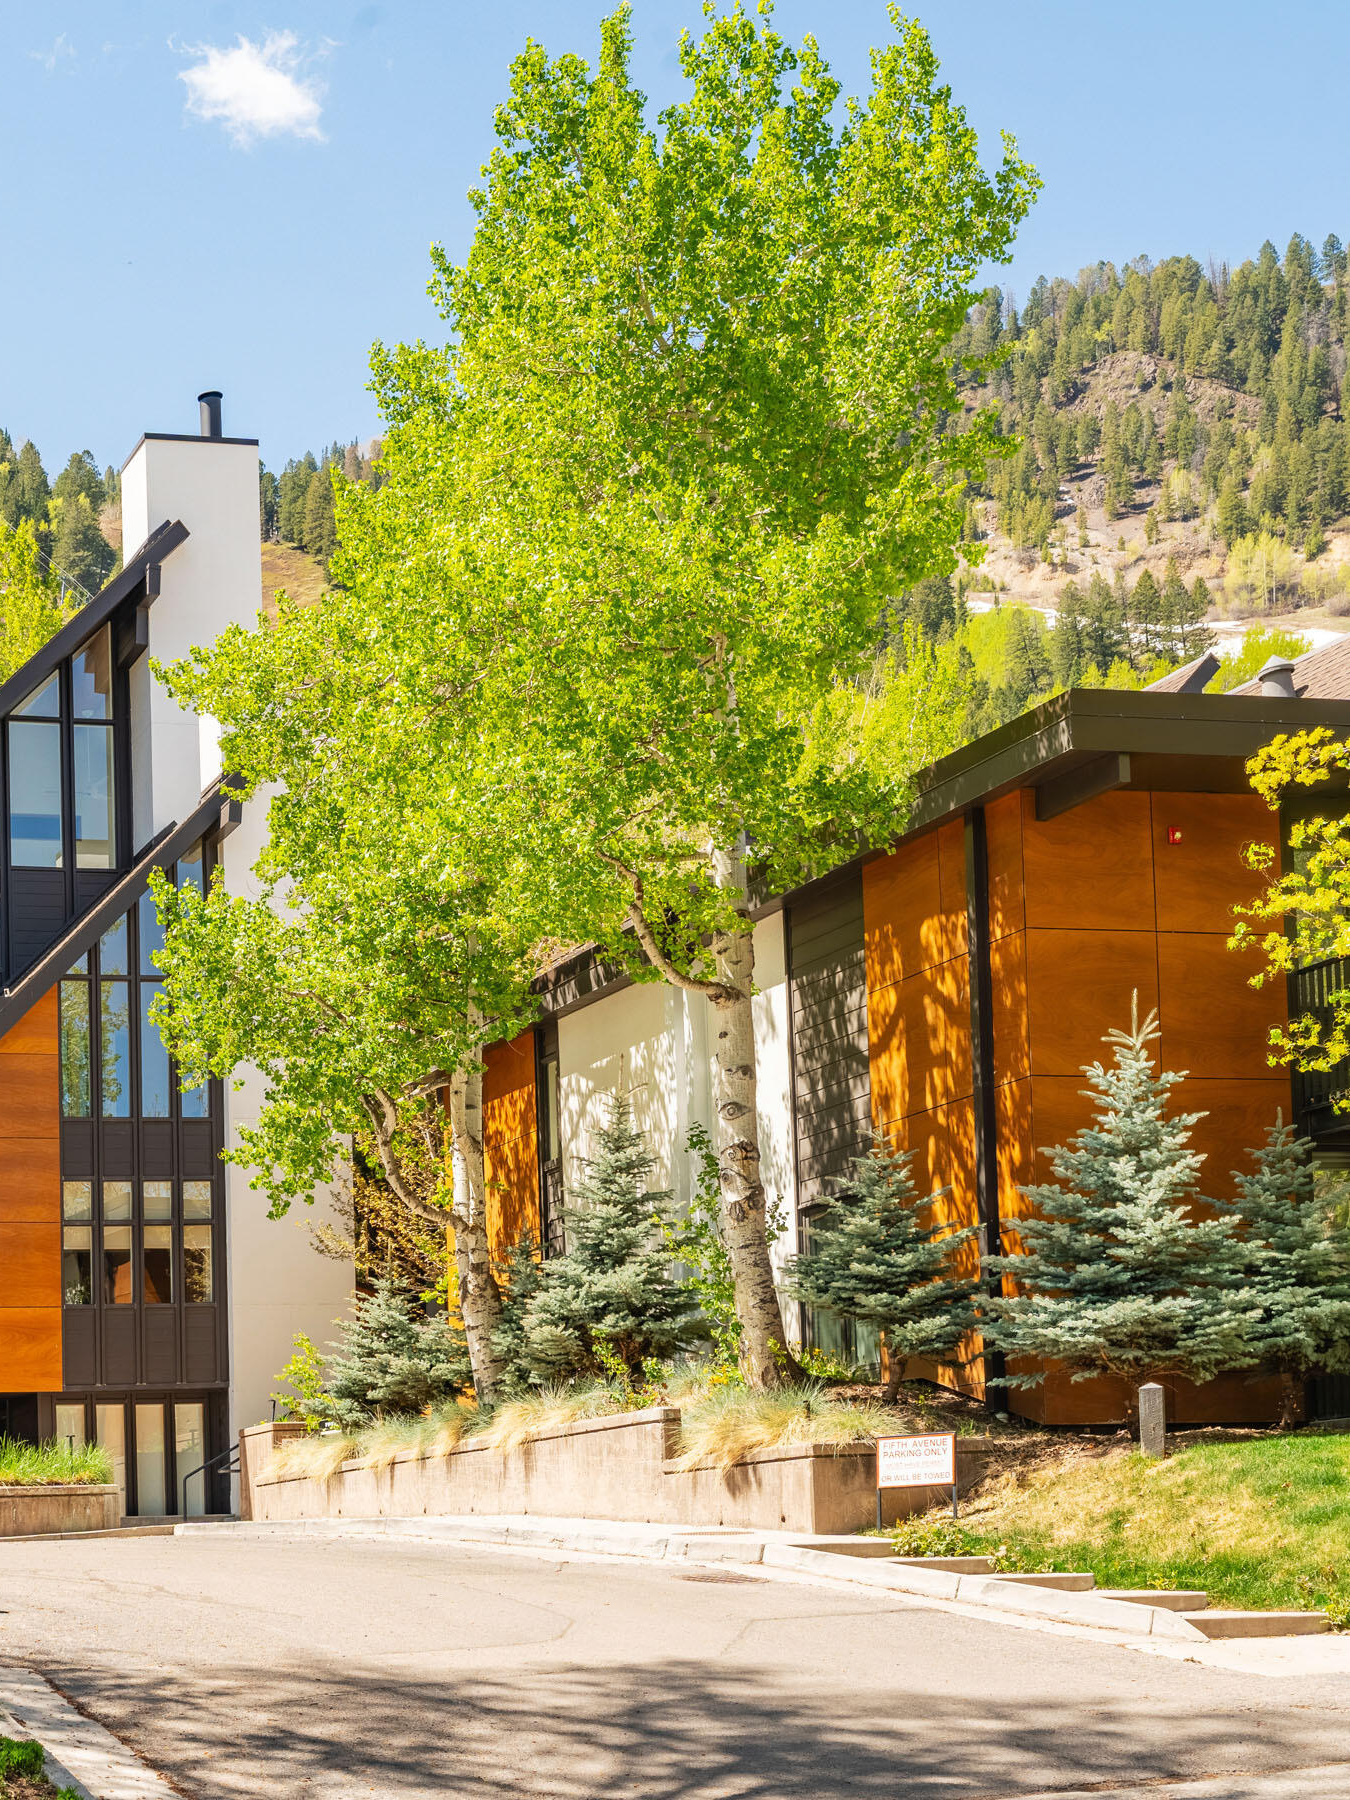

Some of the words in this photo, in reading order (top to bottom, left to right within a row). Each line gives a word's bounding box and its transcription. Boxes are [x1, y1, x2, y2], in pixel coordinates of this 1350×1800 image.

[883, 1441, 908, 1449] FIFTH
[911, 1437, 948, 1448] AVENUE
[883, 1449, 922, 1459] PARKING
[923, 1447, 948, 1457] ONLY
[924, 1471, 951, 1480] TOWED
